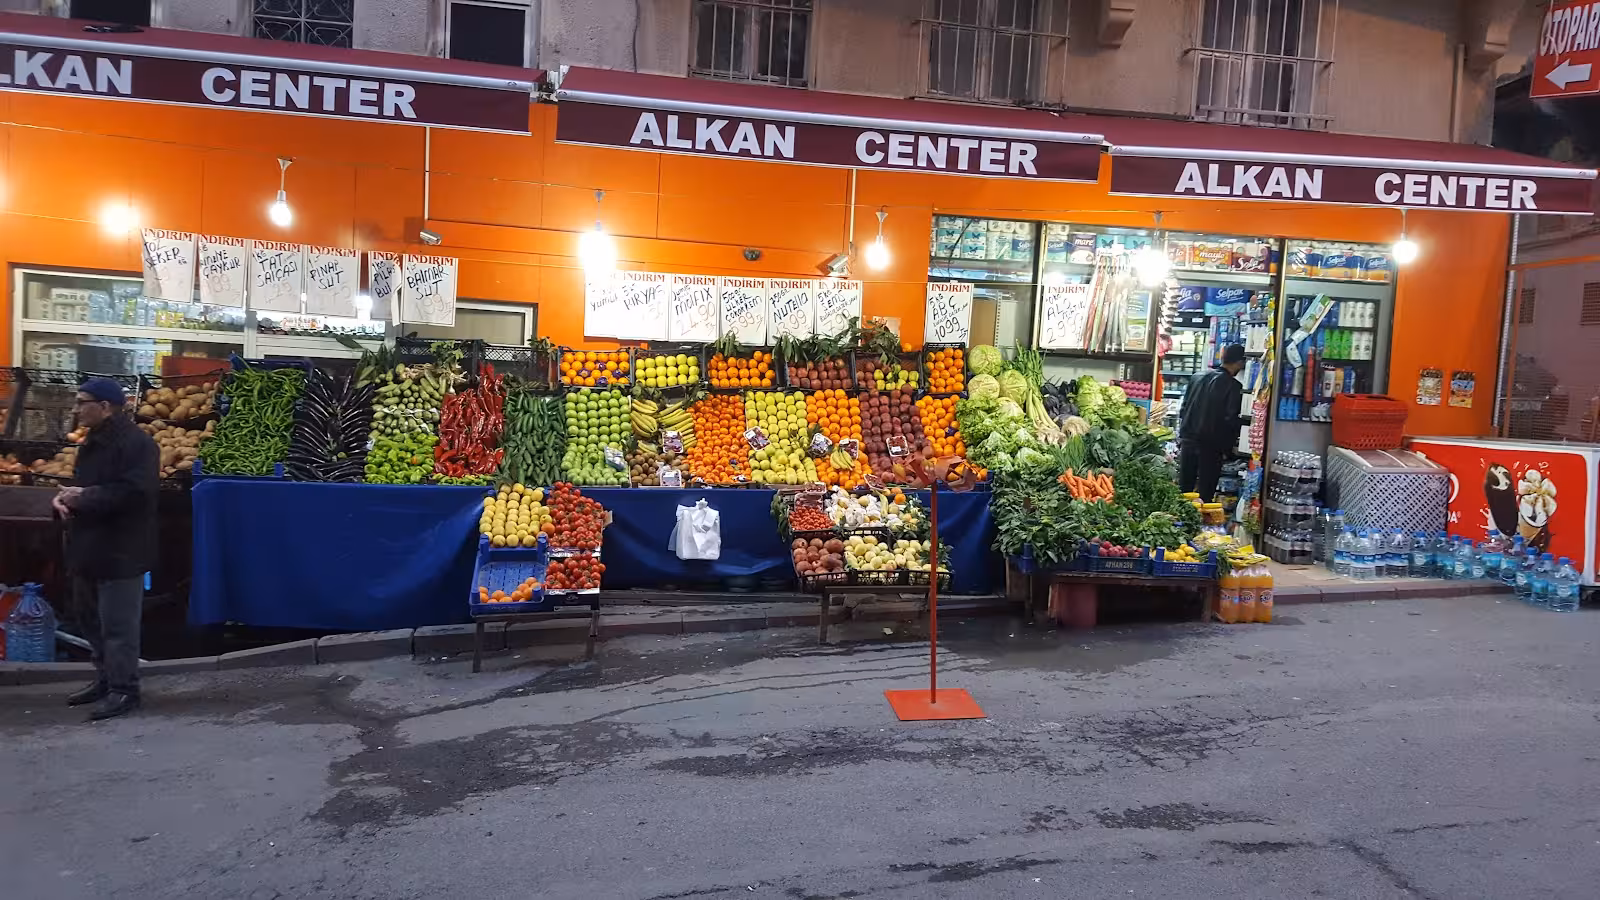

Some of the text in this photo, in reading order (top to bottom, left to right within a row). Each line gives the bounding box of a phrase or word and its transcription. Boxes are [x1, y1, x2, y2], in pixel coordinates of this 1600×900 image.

[1540, 2, 1600, 56] OTOPAR
[201, 67, 416, 119] CENTER
[629, 112, 1038, 175] ALKAN CENTER
[1174, 162, 1538, 210] ALKAN CENTER
[1216, 288, 1244, 299] Selpak
